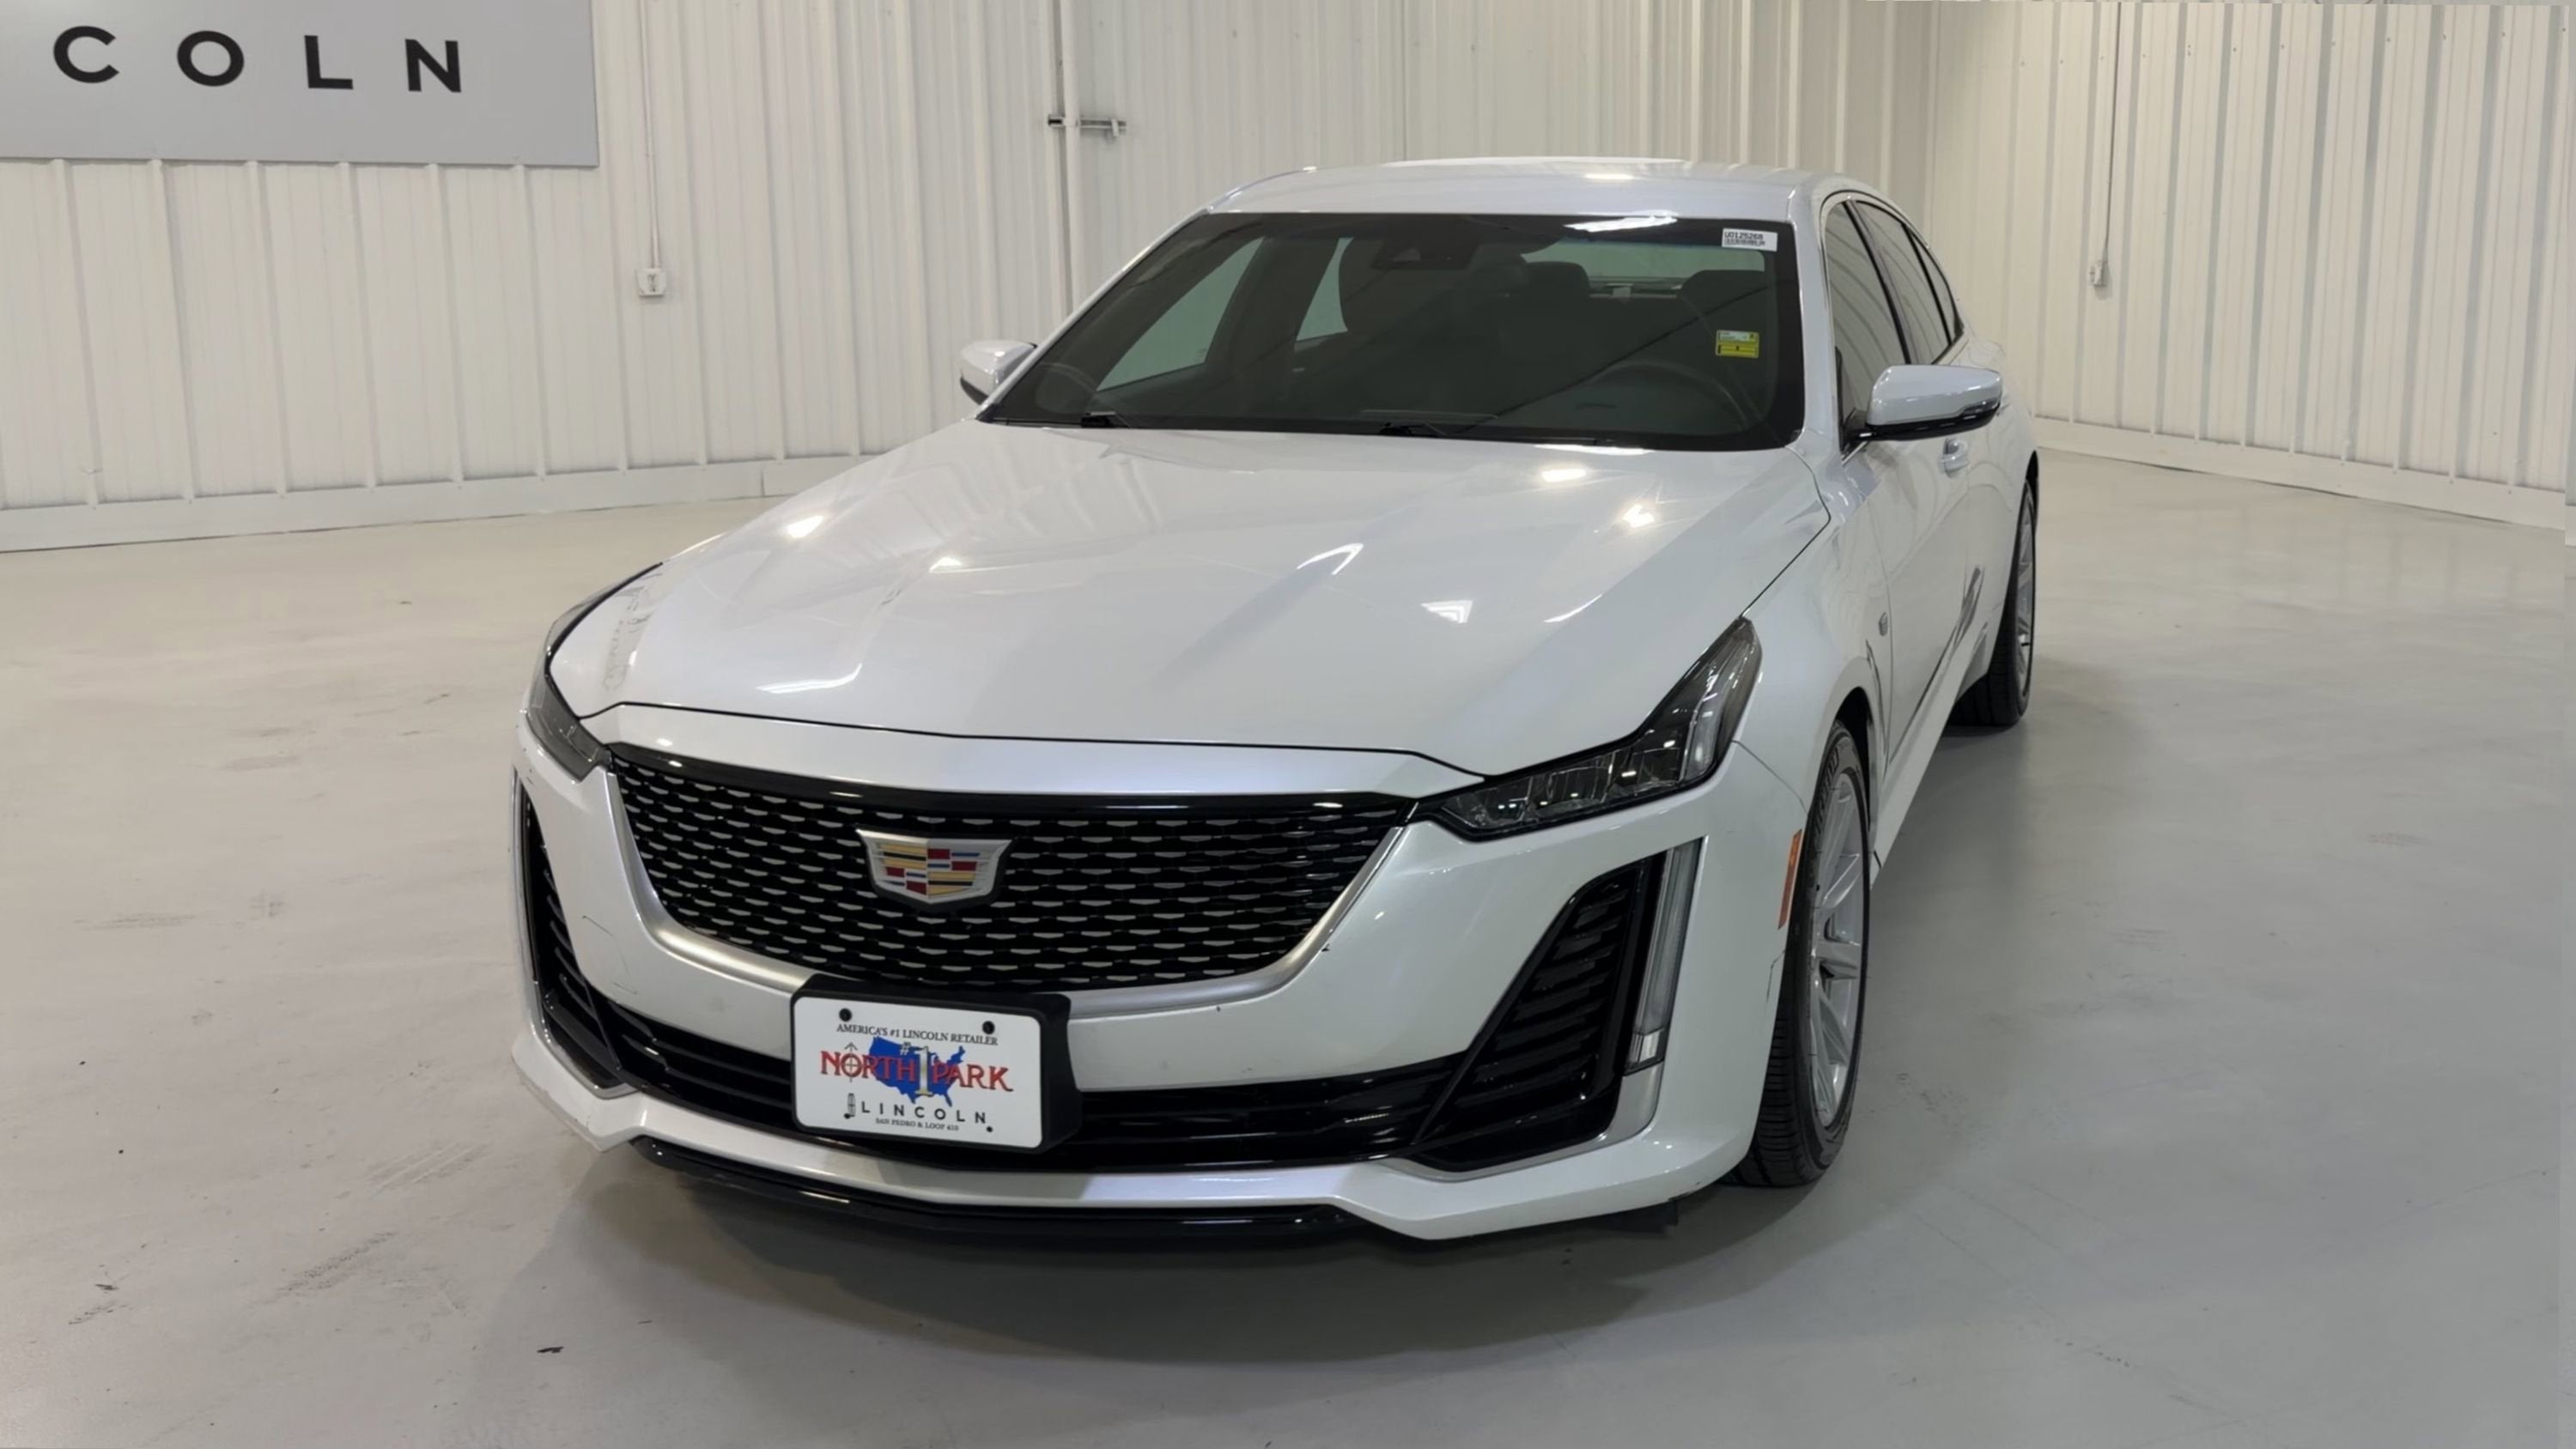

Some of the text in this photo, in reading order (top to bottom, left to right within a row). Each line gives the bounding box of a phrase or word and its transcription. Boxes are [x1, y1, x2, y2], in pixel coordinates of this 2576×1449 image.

[836, 1023, 999, 1046] AMERICA'S #1 LINCOLN RETAILER
[820, 1050, 1014, 1093] NORTH PARK
[861, 1100, 987, 1124] LINCOLN
[890, 1119, 916, 1128] PEDRO
